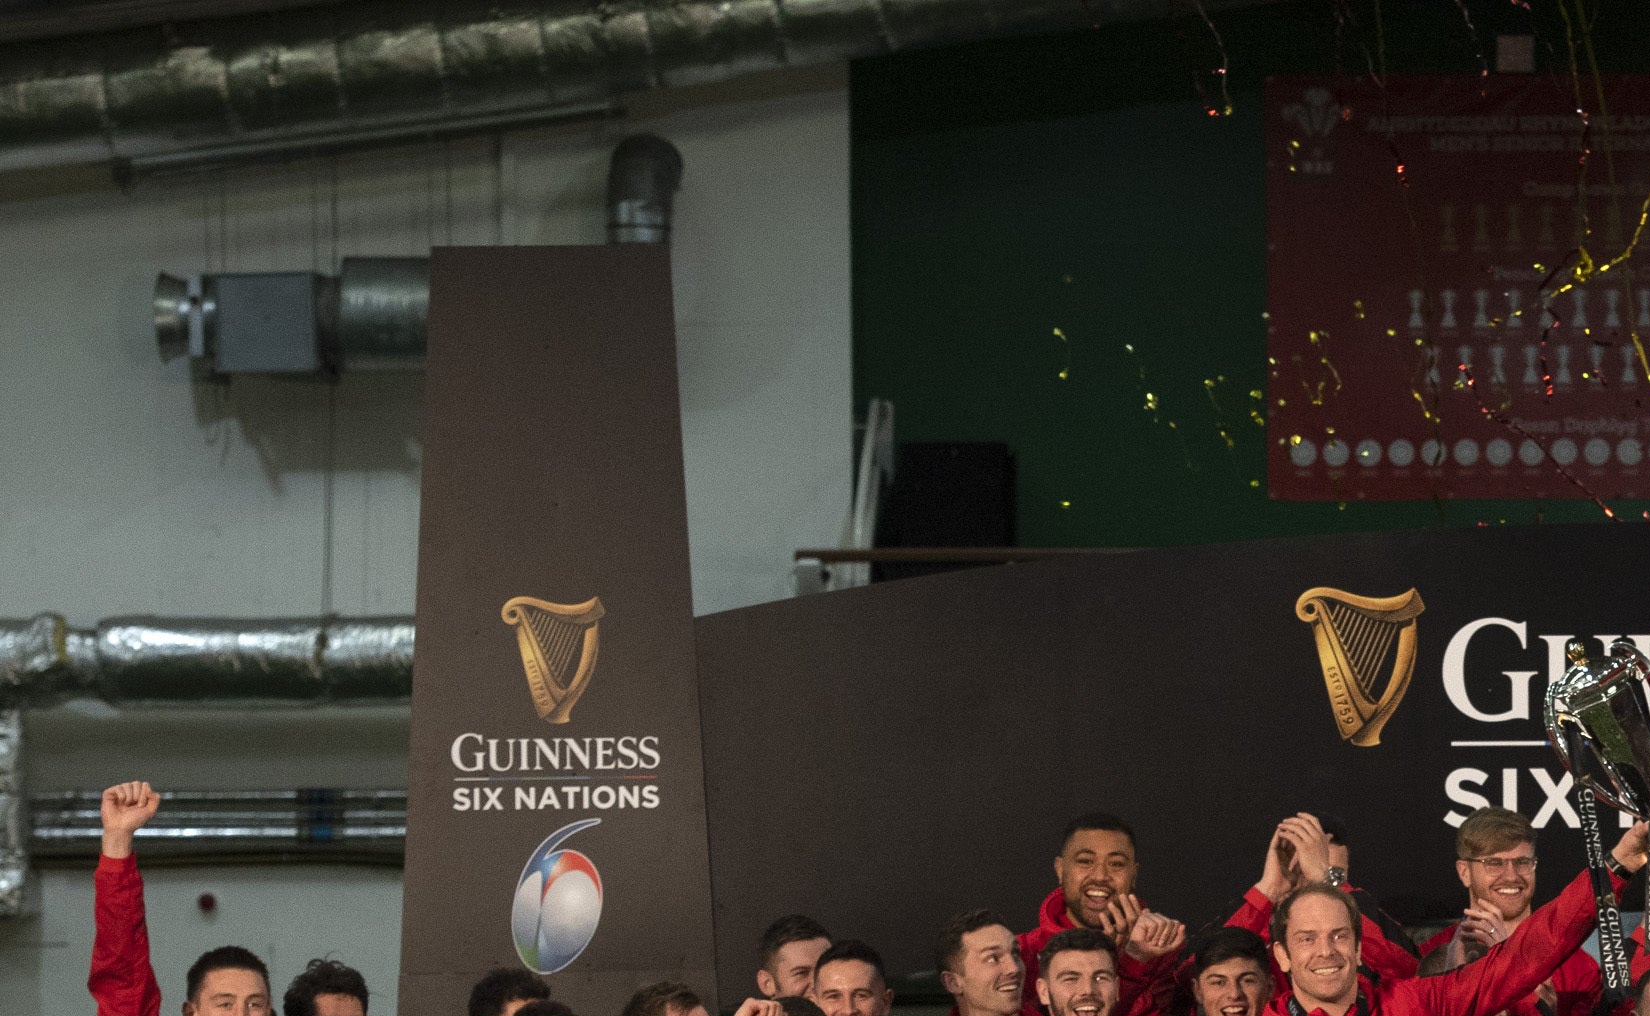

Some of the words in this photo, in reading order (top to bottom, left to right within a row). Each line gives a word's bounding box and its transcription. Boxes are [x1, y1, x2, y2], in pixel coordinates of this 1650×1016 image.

[1334, 694, 1355, 725] 1759
[451, 732, 662, 773] GUINNESS
[452, 785, 505, 812] SIX
[515, 784, 662, 812] NATIONS
[1443, 767, 1582, 829] SIX
[1583, 788, 1604, 868] GUINNESS
[1606, 907, 1630, 987] GUINNESS
